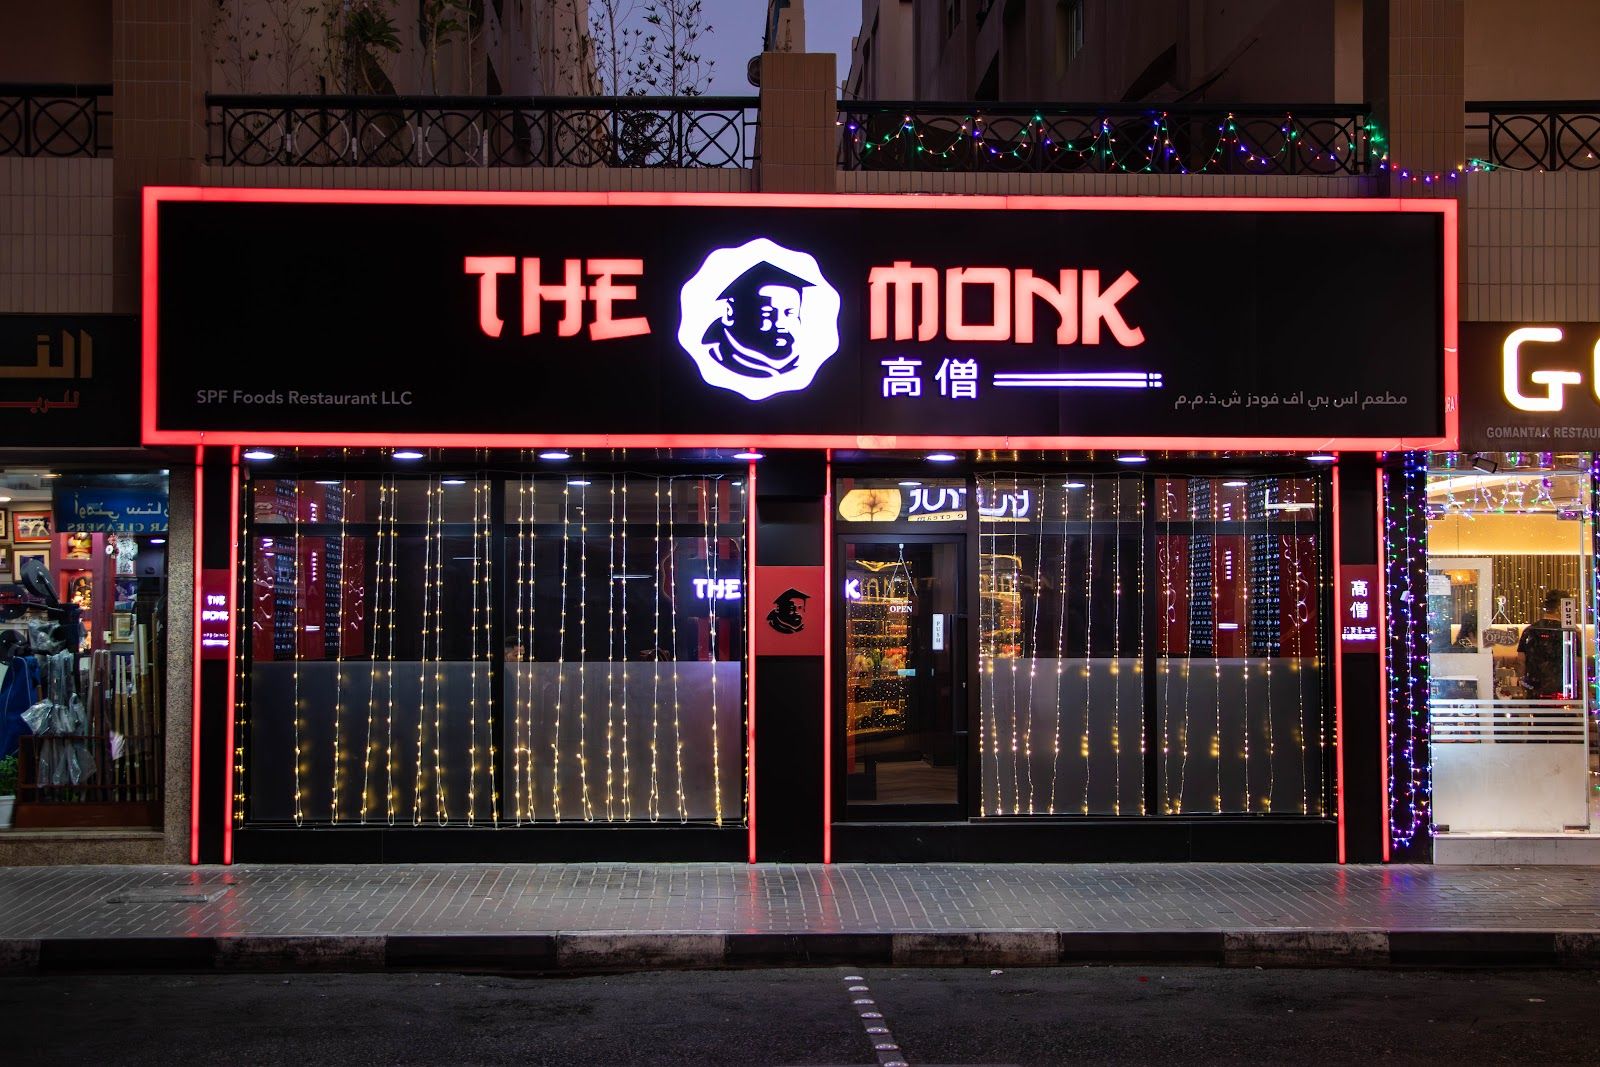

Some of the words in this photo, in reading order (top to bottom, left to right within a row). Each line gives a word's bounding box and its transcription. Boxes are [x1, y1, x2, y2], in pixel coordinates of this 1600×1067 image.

[463, 256, 651, 341] THE
[867, 261, 1146, 347] MONK
[880, 356, 979, 399] 高僧
[1503, 327, 1600, 412] G
[196, 389, 229, 405] SPF
[233, 389, 284, 405] Foods
[288, 390, 378, 406] Restaurant
[381, 391, 413, 406] LLC
[1245, 391, 1280, 408] فودز
[1307, 393, 1329, 411] بي
[1361, 391, 1408, 410] مطعم
[1486, 426, 1550, 439] GOMANTAK
[693, 578, 742, 600] THE
[889, 605, 913, 613] OPEN
[1486, 632, 1516, 645] OPEN
